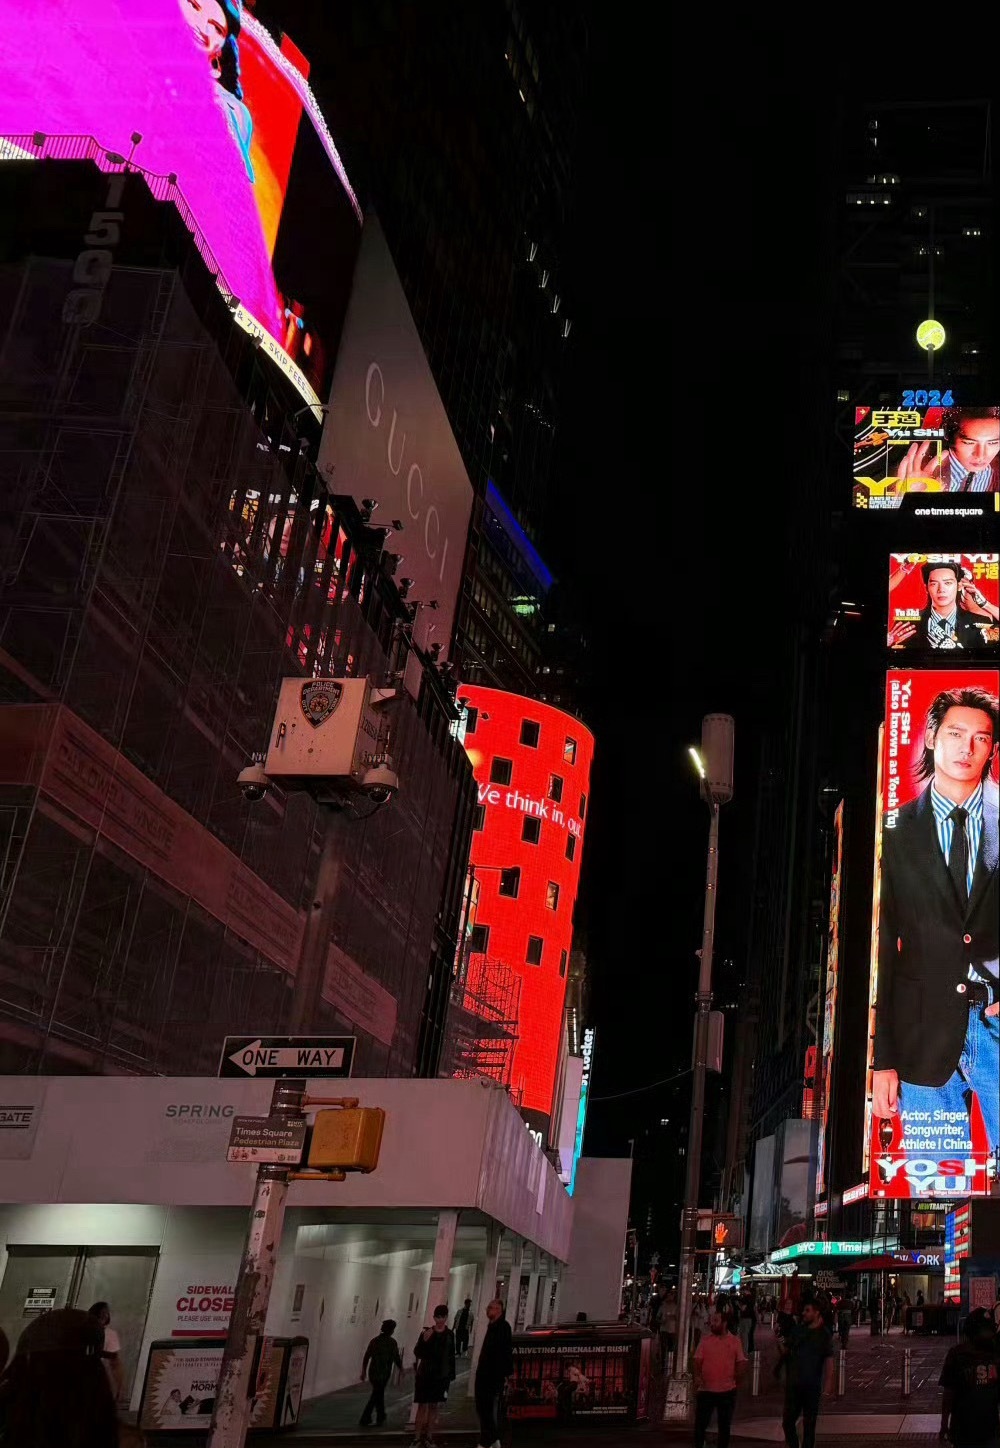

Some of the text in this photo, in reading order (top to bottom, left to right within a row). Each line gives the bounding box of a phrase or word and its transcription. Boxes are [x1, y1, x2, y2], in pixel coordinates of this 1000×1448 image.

[269, 342, 288, 365] SKIP
[902, 390, 955, 406] 2026
[883, 428, 944, 437] Yu Shi
[366, 362, 449, 582] GUCCI
[931, 507, 953, 515] times
[955, 507, 983, 517] square
[900, 678, 911, 745] Yu Shi
[889, 761, 899, 773] as
[505, 790, 549, 818] think
[242, 1049, 336, 1066] ONE WAY
[166, 1105, 234, 1117] SPRING
[901, 1109, 969, 1124] Actor, Singer,
[236, 1128, 293, 1137] Times Square
[903, 1124, 965, 1138] Songwriter,
[233, 1137, 300, 1147] Pedestrian Plaza
[898, 1138, 973, 1150] Athlete China
[874, 1158, 997, 1176] YOSH
[904, 1176, 967, 1191] YU
[186, 1285, 235, 1295] SIDEWAL
[176, 1297, 236, 1312] CLOSE
[191, 1383, 218, 1391] MORM
